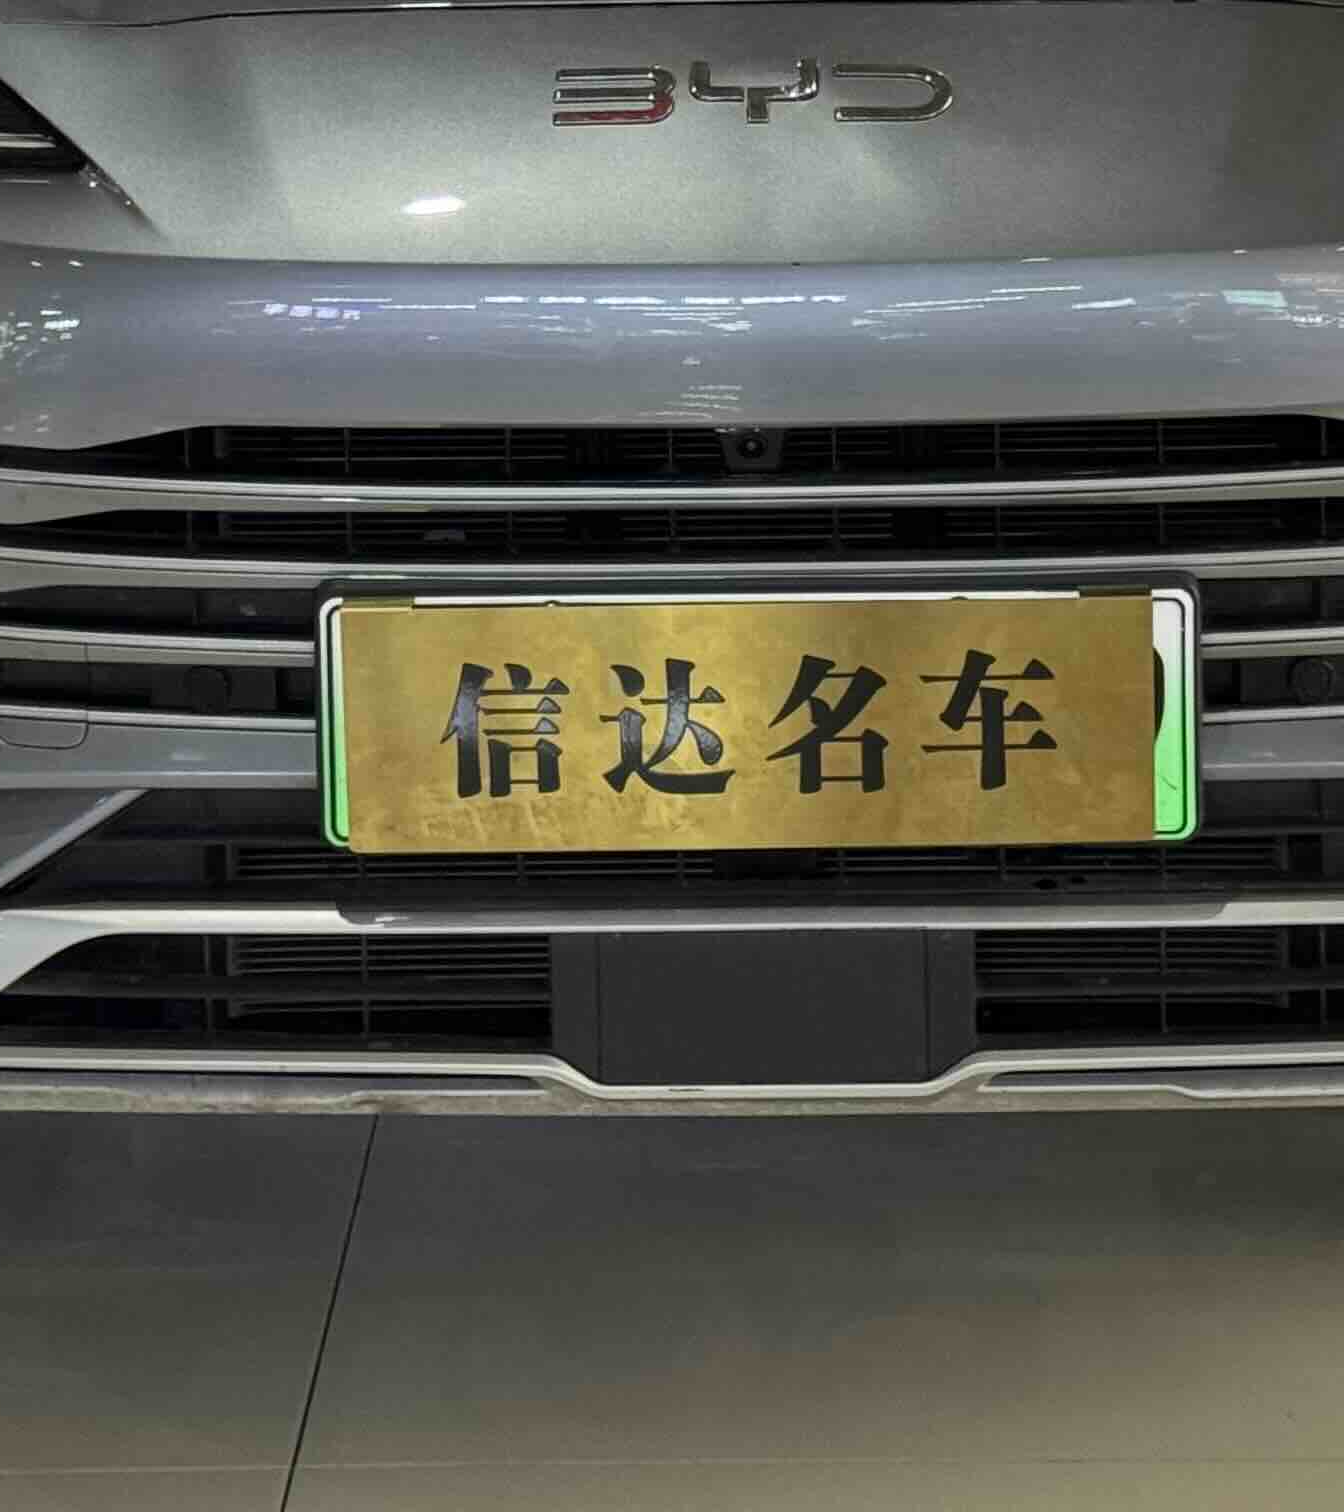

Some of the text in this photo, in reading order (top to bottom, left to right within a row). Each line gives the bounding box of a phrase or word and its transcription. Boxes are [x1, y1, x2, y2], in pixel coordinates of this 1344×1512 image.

[552, 58, 953, 126] BYD
[439, 648, 1058, 799] 信达名车
